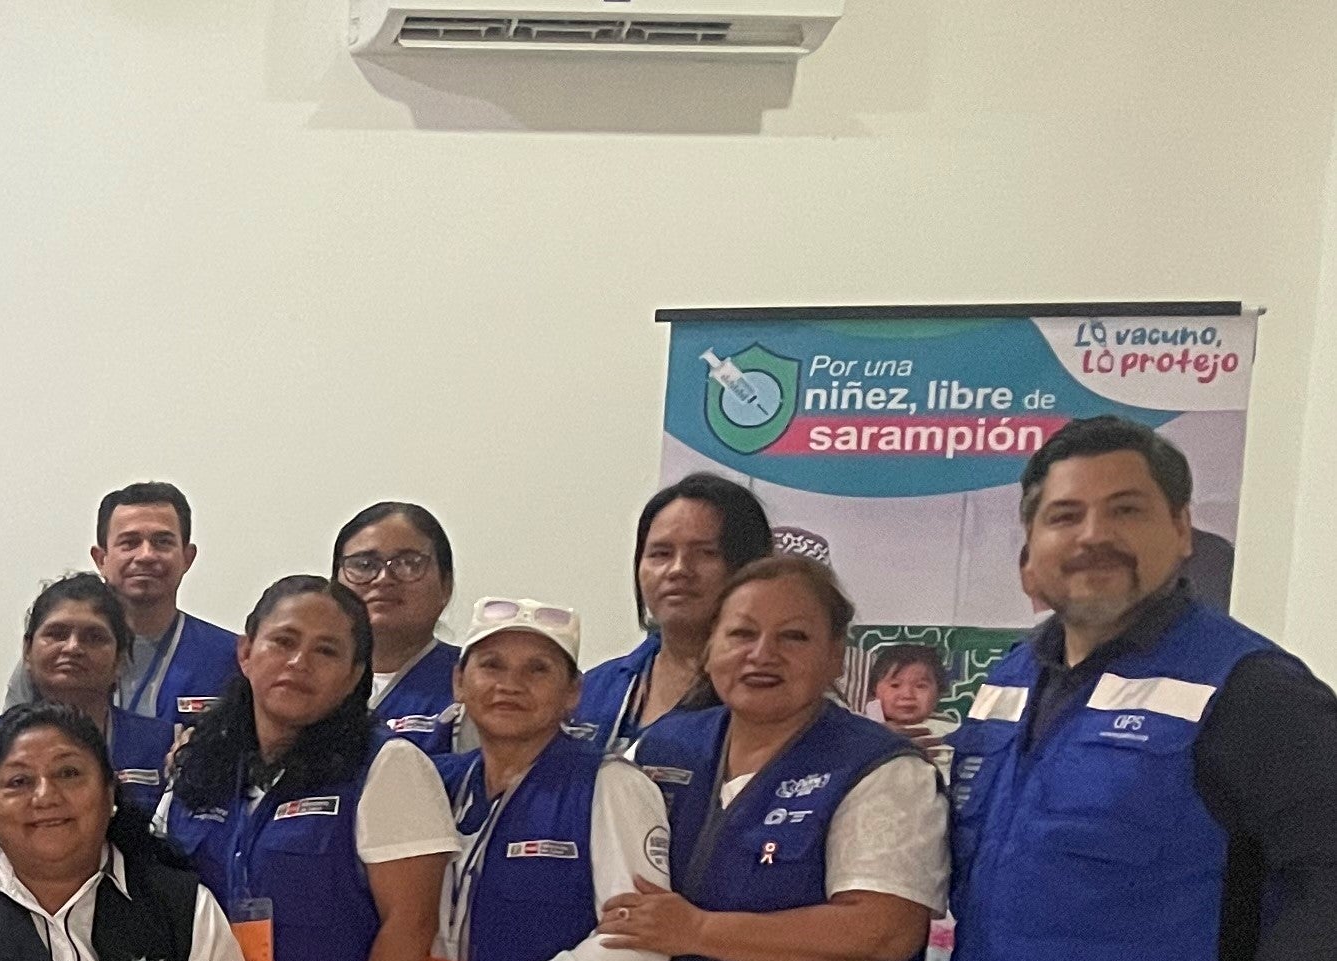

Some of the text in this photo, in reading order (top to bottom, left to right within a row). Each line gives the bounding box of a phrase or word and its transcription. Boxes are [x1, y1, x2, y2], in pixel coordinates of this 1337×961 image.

[809, 355, 913, 377] Por una
[1120, 349, 1239, 384] protejo
[804, 380, 1056, 415] niñez, libre de
[809, 417, 1044, 459] sarampión
